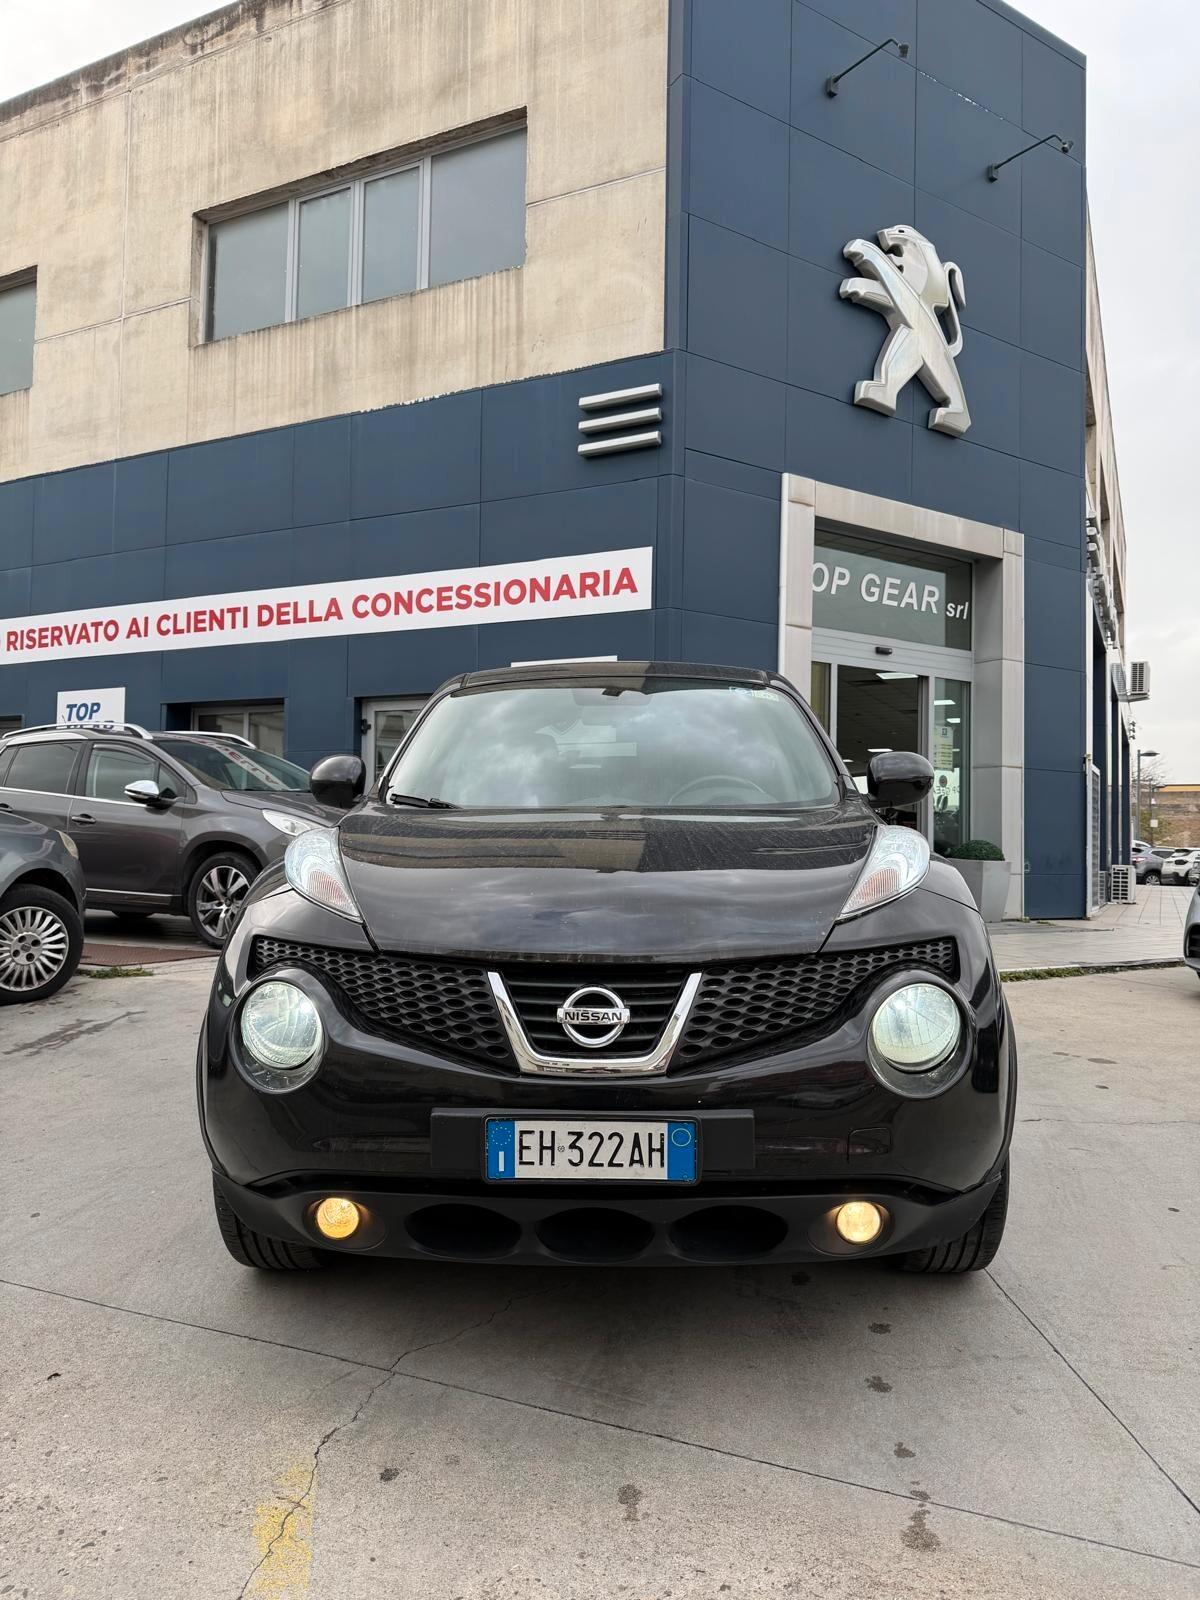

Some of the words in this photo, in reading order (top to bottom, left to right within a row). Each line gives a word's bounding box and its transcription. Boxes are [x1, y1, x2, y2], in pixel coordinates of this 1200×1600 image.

[6, 619, 120, 651] RISERVATO
[125, 616, 149, 639] AI
[156, 606, 249, 637] CLIENTI
[256, 598, 343, 627] DELLA
[352, 567, 638, 619] CONCESSIONARIA
[811, 562, 851, 595] OP
[860, 573, 940, 614] GEAR
[946, 601, 969, 620] srl
[66, 702, 101, 722] TOP
[564, 1011, 622, 1021] NISSAN
